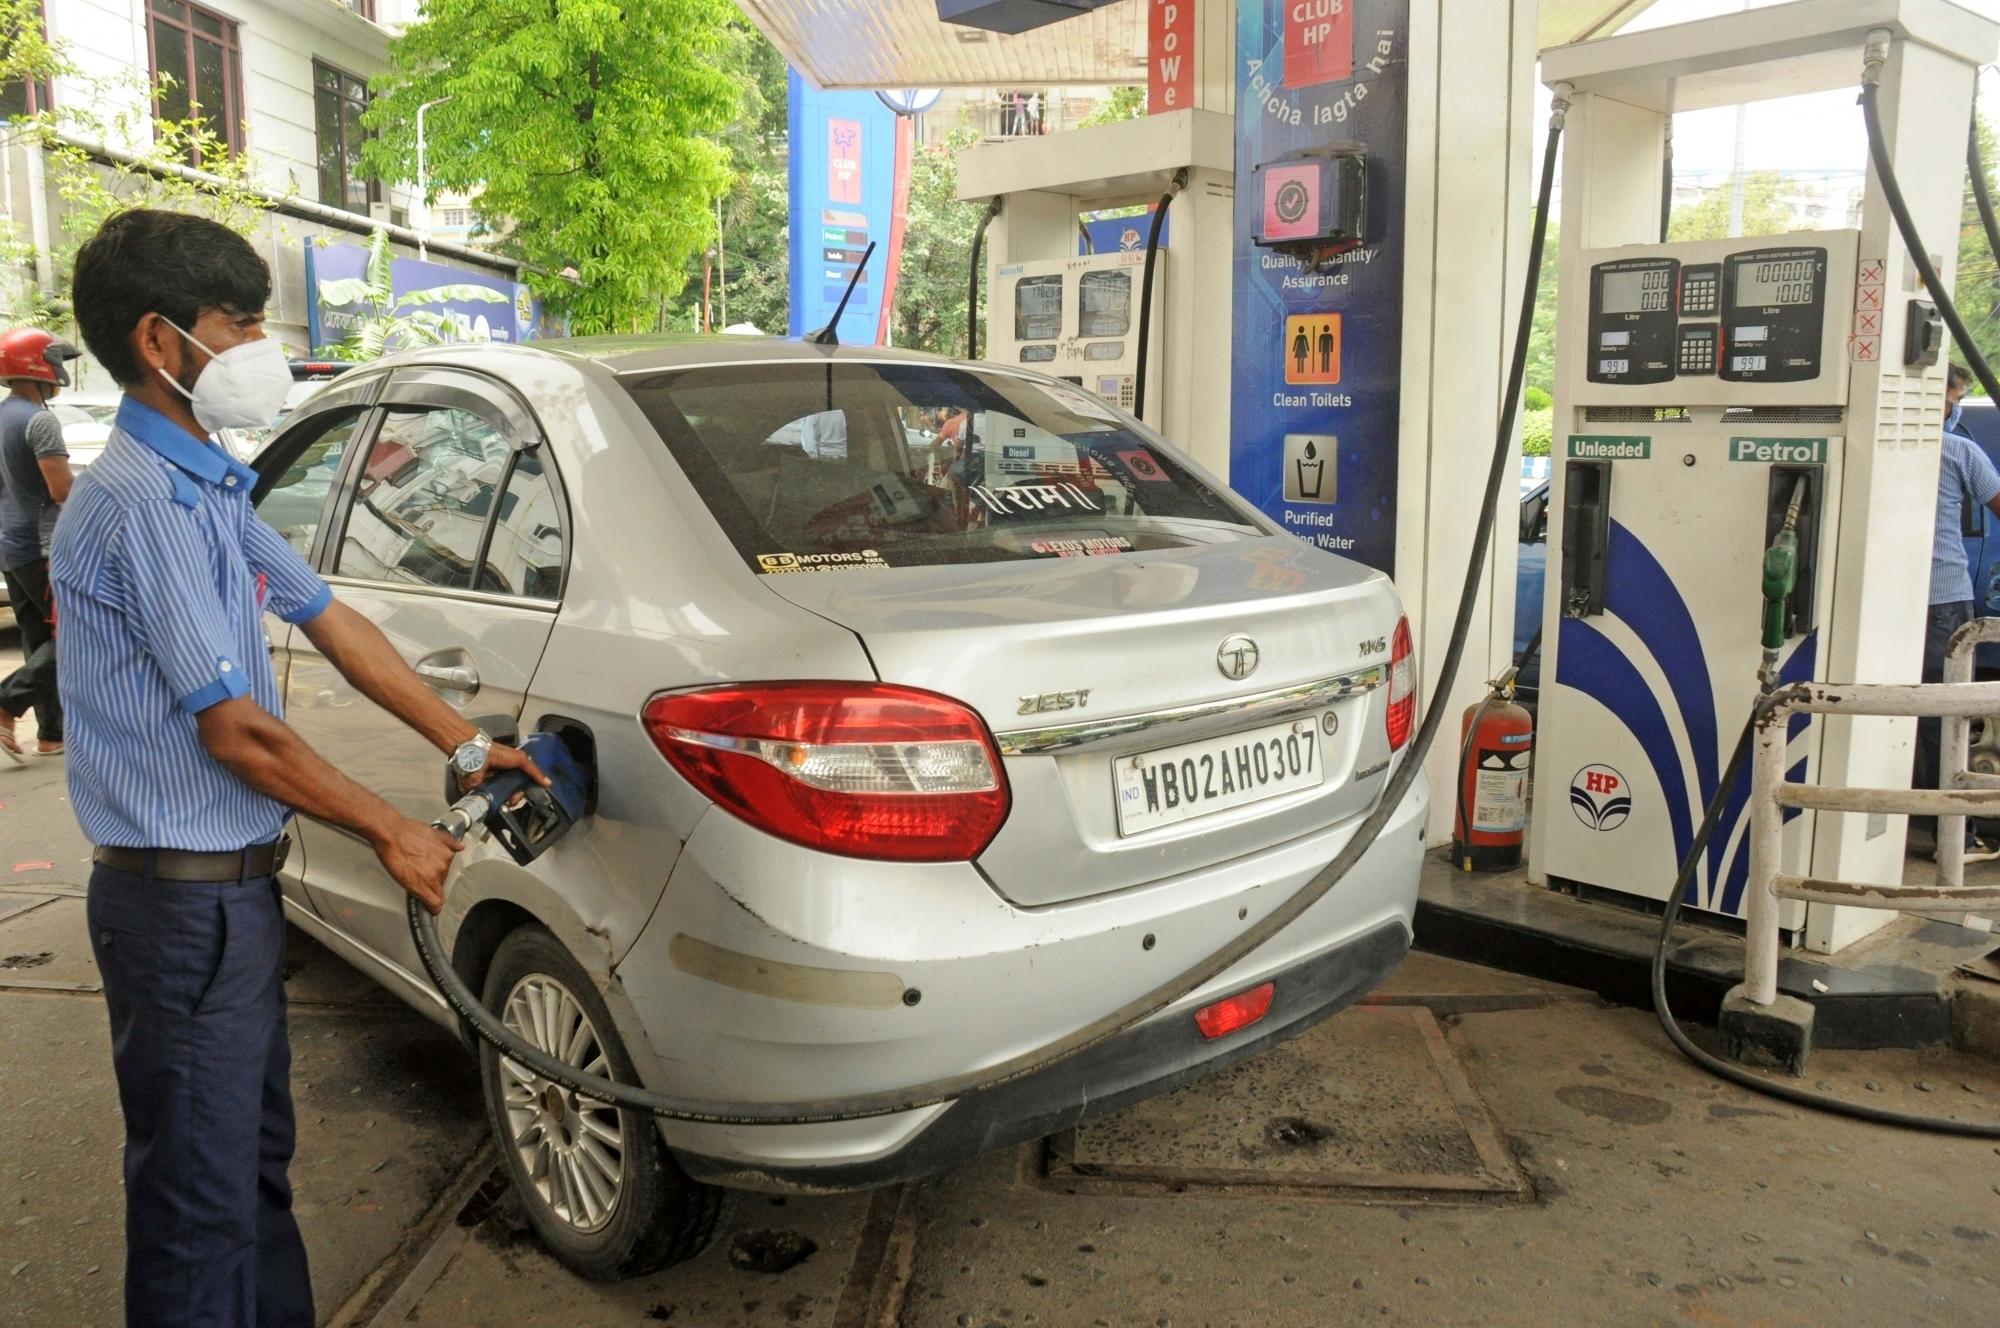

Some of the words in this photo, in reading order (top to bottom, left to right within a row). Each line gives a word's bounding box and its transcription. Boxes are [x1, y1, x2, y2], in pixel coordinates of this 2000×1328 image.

[1293, 0, 1343, 22] CLUB
[1303, 23, 1332, 46] HP
[1247, 59, 1302, 126] Achcha
[1314, 82, 1368, 126] lagta
[1366, 30, 1394, 74] hai
[1125, 232, 1136, 242] HP
[1262, 256, 1302, 270] Quality
[1282, 274, 1348, 288] Assurance
[1274, 393, 1307, 406] Clean
[1310, 393, 1351, 407] Toilets
[1008, 448, 1029, 457] Diesel
[1575, 442, 1643, 457] Unleaded
[1738, 440, 1818, 461] Petrol
[1285, 510, 1333, 527] Purified
[1082, 537, 1131, 551] MOTORS
[1318, 534, 1355, 550] Water
[797, 552, 862, 564] MOTORS
[1017, 688, 1092, 715] ZEST
[1142, 730, 1316, 812] WB02AH0307
[1586, 772, 1618, 794] HP
[1122, 787, 1140, 801] IND
